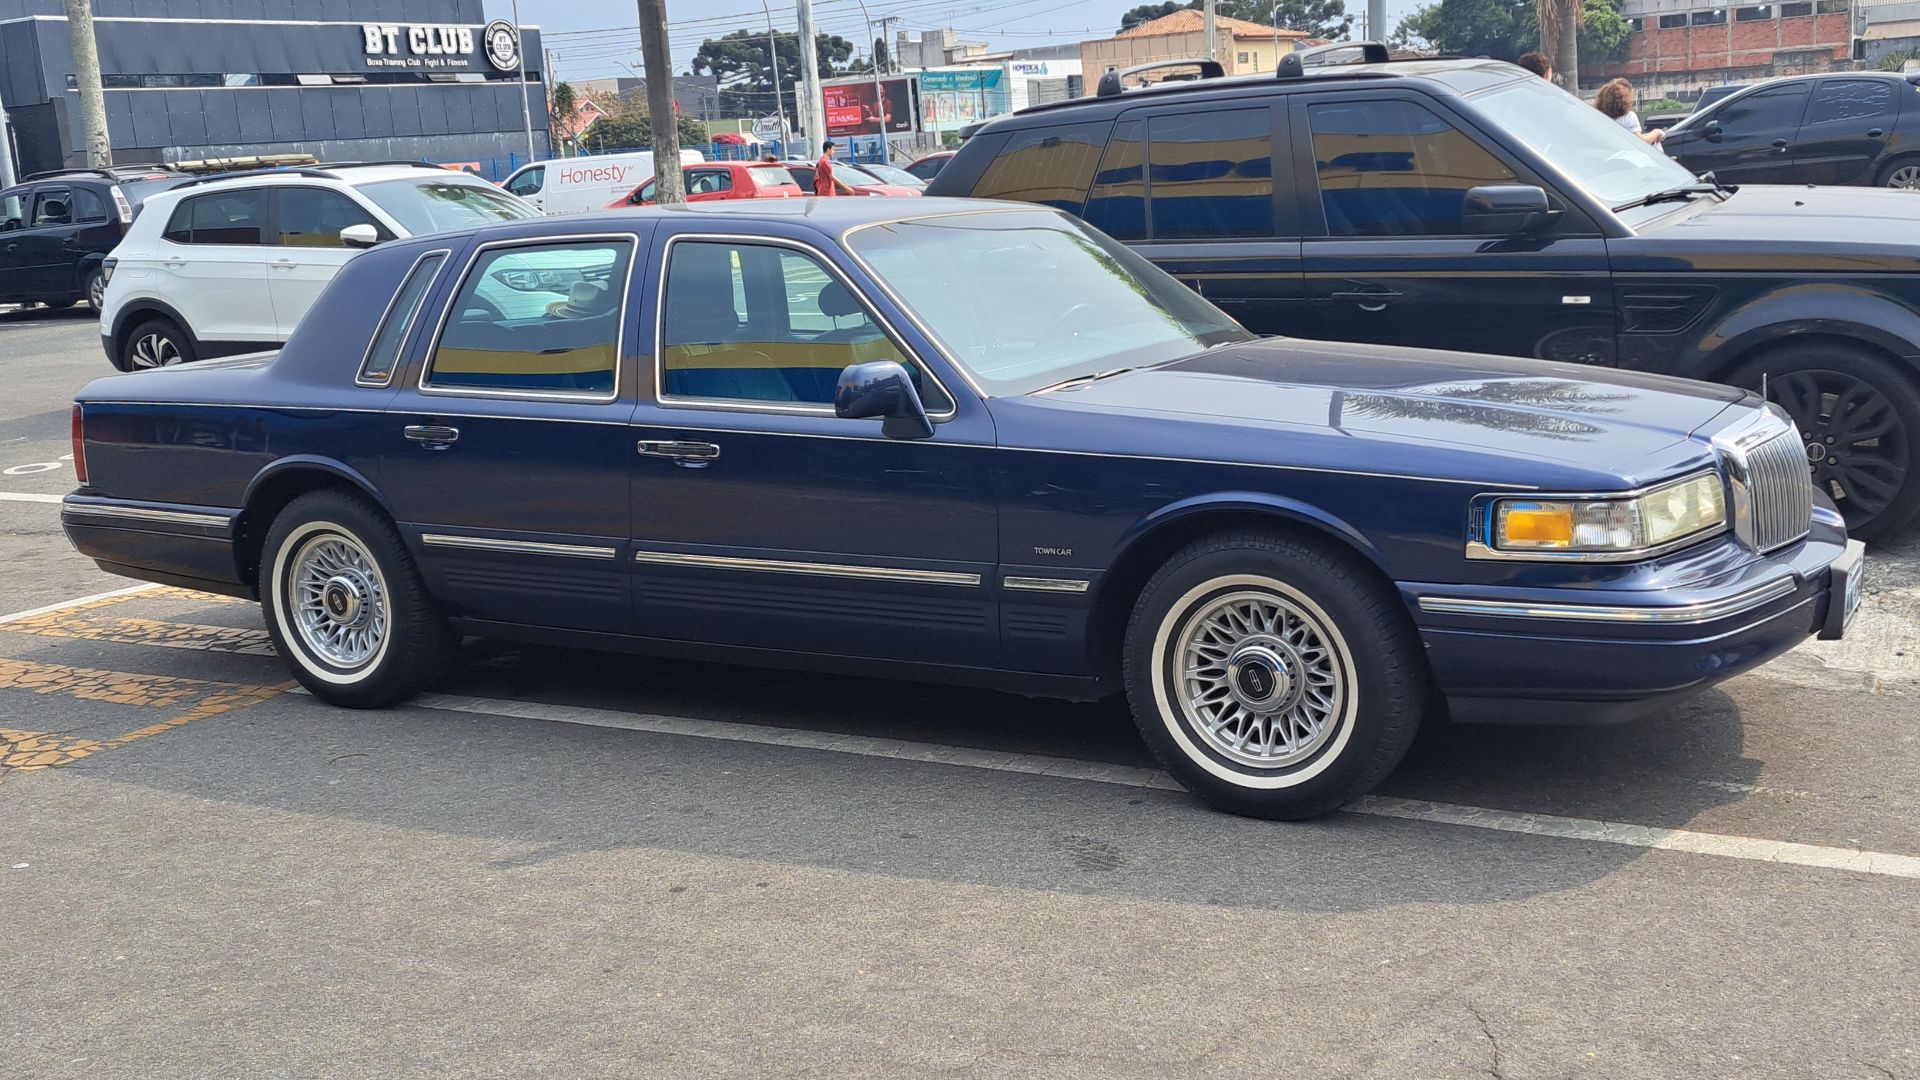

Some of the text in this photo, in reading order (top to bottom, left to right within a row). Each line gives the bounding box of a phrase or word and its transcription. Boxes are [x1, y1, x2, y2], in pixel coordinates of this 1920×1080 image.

[363, 25, 474, 54] BT CLUB
[382, 58, 406, 68] Training
[407, 58, 421, 66] Club
[424, 58, 439, 68] Fight
[447, 58, 468, 66] Fitness
[560, 163, 627, 184] Honesty
[1033, 546, 1072, 556] TOWN CAR
